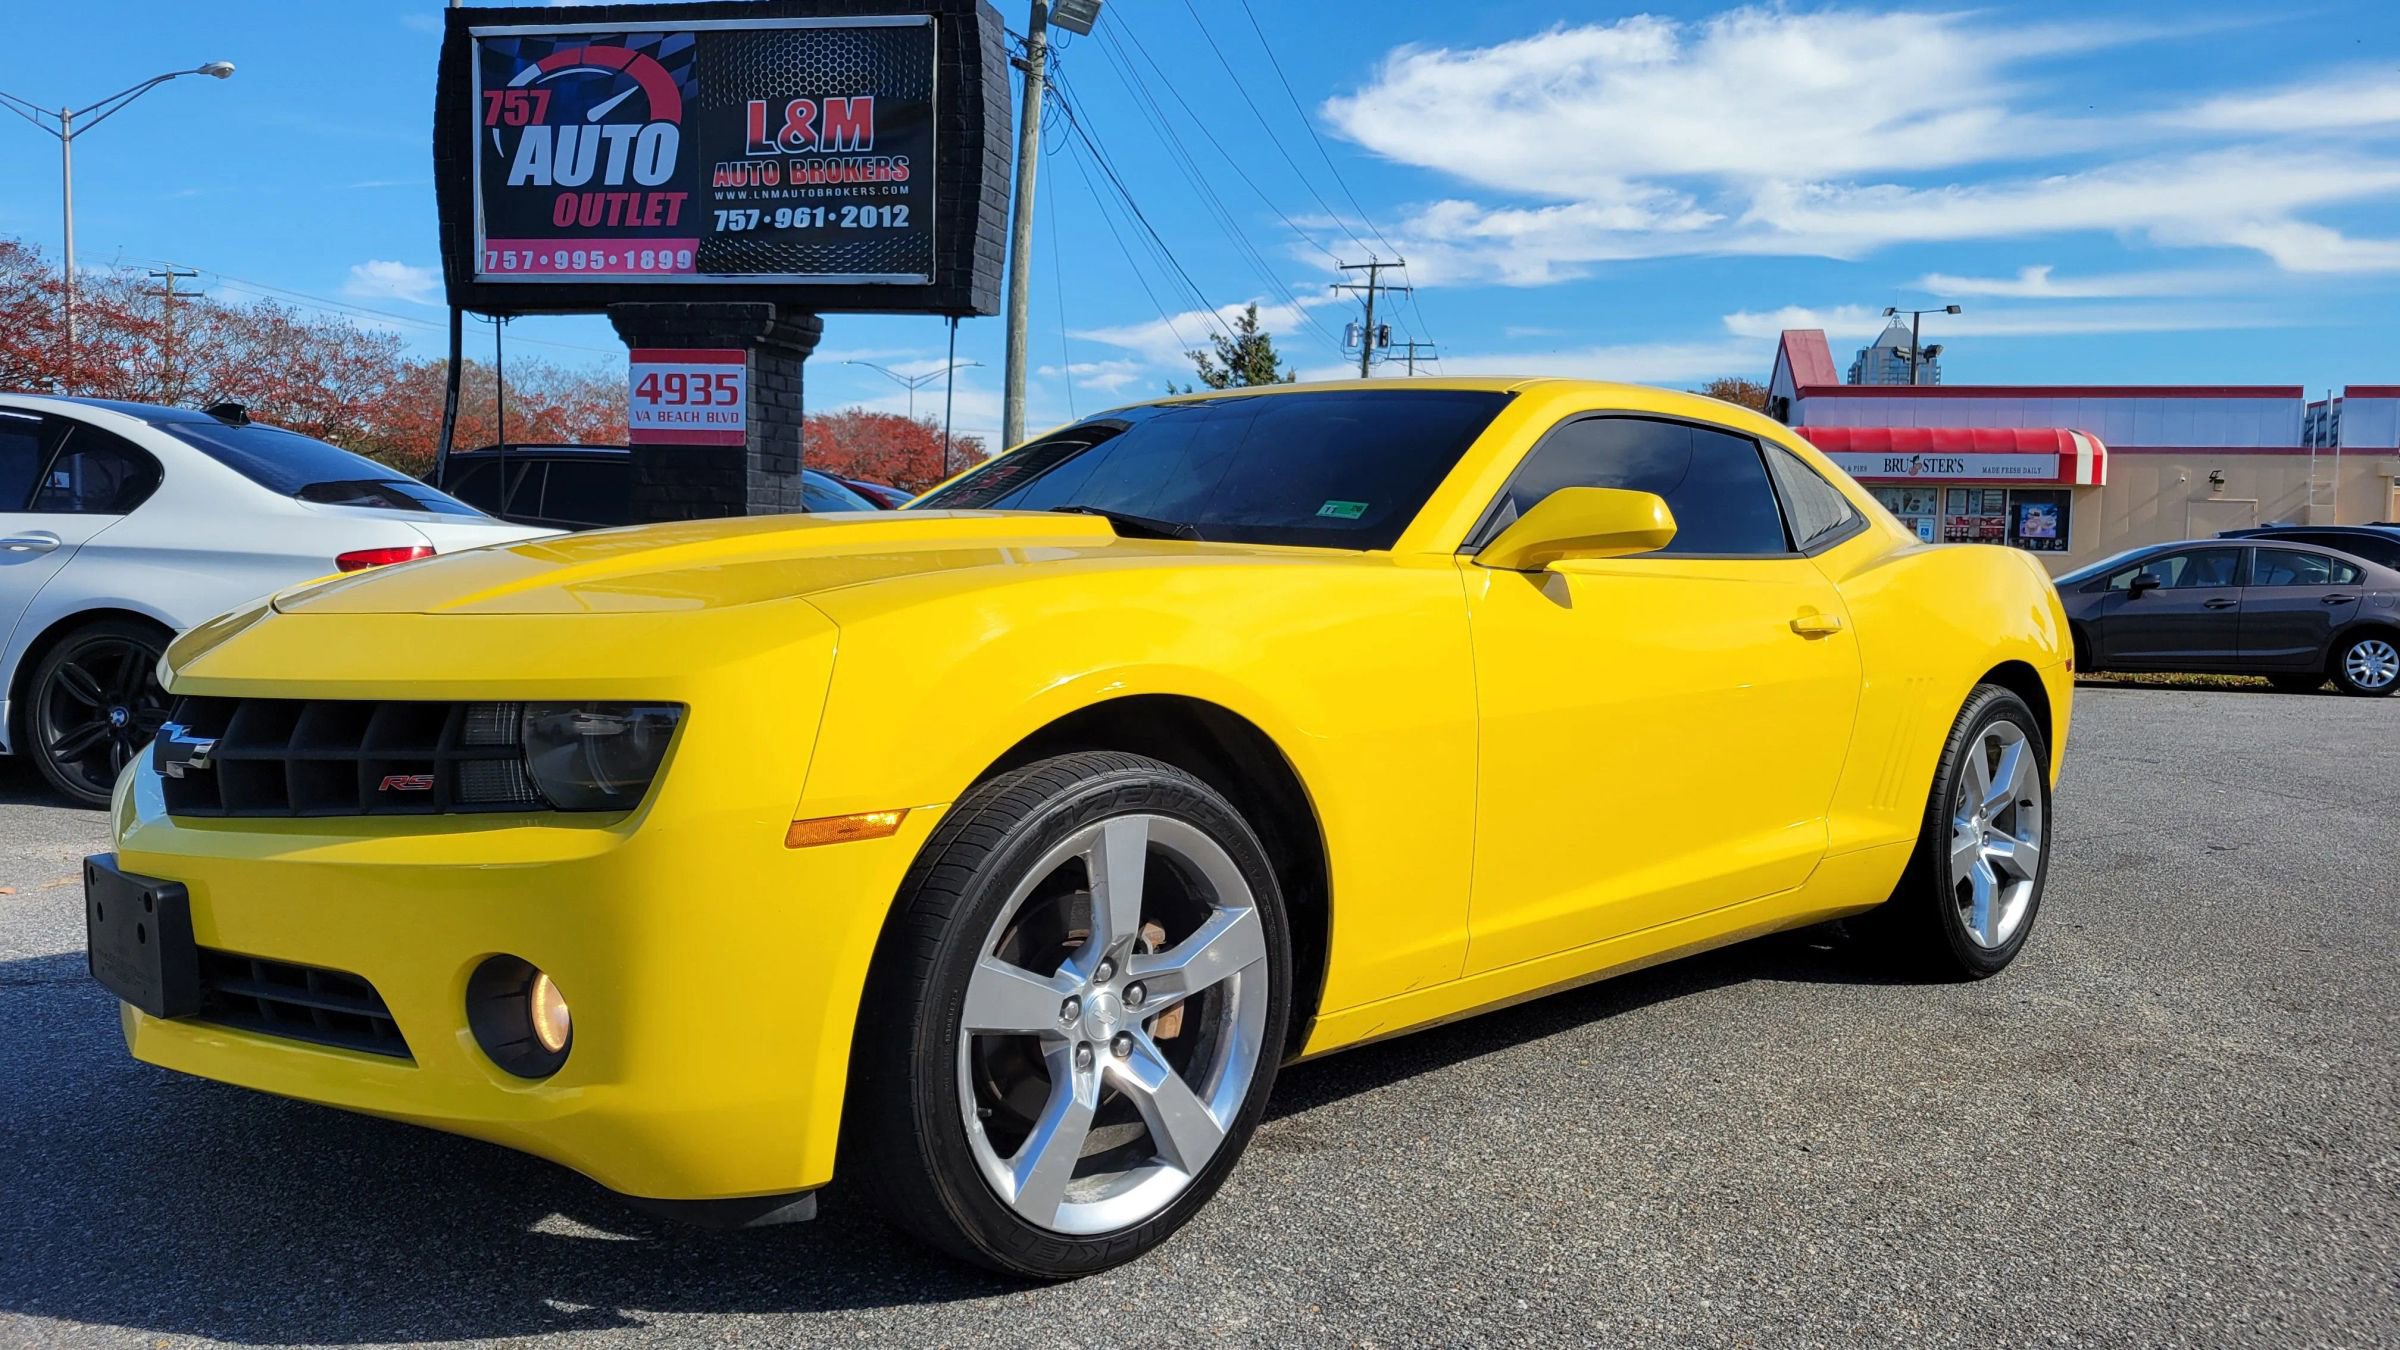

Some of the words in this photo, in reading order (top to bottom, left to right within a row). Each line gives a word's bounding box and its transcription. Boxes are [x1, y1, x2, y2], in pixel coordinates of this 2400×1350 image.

[484, 89, 552, 126] 757
[746, 96, 874, 156] L&M
[507, 122, 680, 187] AUTO
[712, 159, 780, 188] AUTO
[789, 156, 910, 185] BROKERS
[714, 185, 909, 201] WWW.LNMAUTOBROKERS.COM
[552, 192, 688, 227] OUTLET
[635, 373, 739, 406] 4935
[635, 410, 651, 422] VA
[658, 411, 700, 423] BEACH
[706, 412, 739, 424] BLVD
[1982, 466, 2000, 474] MADE
[2001, 466, 2021, 475] FRESH
[2022, 466, 2042, 475] DAILY
[378, 774, 435, 791] RS
